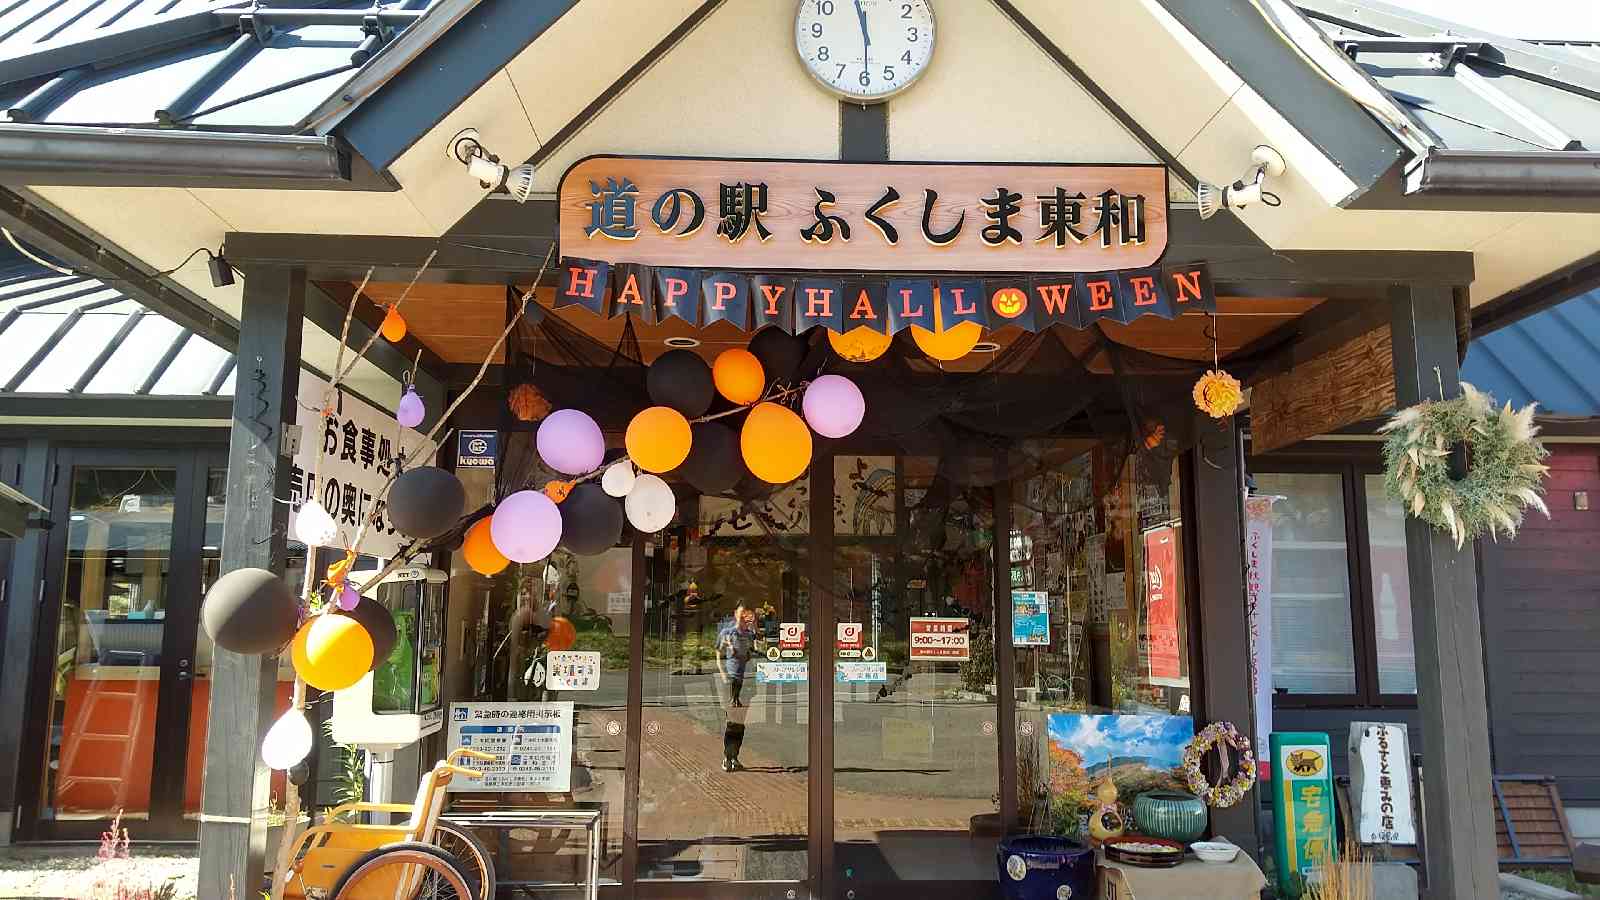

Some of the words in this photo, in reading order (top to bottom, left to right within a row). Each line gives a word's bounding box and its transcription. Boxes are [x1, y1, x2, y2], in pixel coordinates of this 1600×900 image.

[816, 1, 834, 15] 10
[901, 4, 912, 19] 2
[811, 23, 823, 38] 9
[907, 27, 918, 42] 3
[817, 46, 829, 61] 8
[901, 50, 912, 65] 4
[835, 64, 846, 79] 7
[859, 71, 871, 86] 6
[883, 66, 895, 80] 5
[584, 176, 773, 244] 道の駅
[800, 185, 1147, 248] ふくしま東和
[460, 456, 495, 465] kyowa
